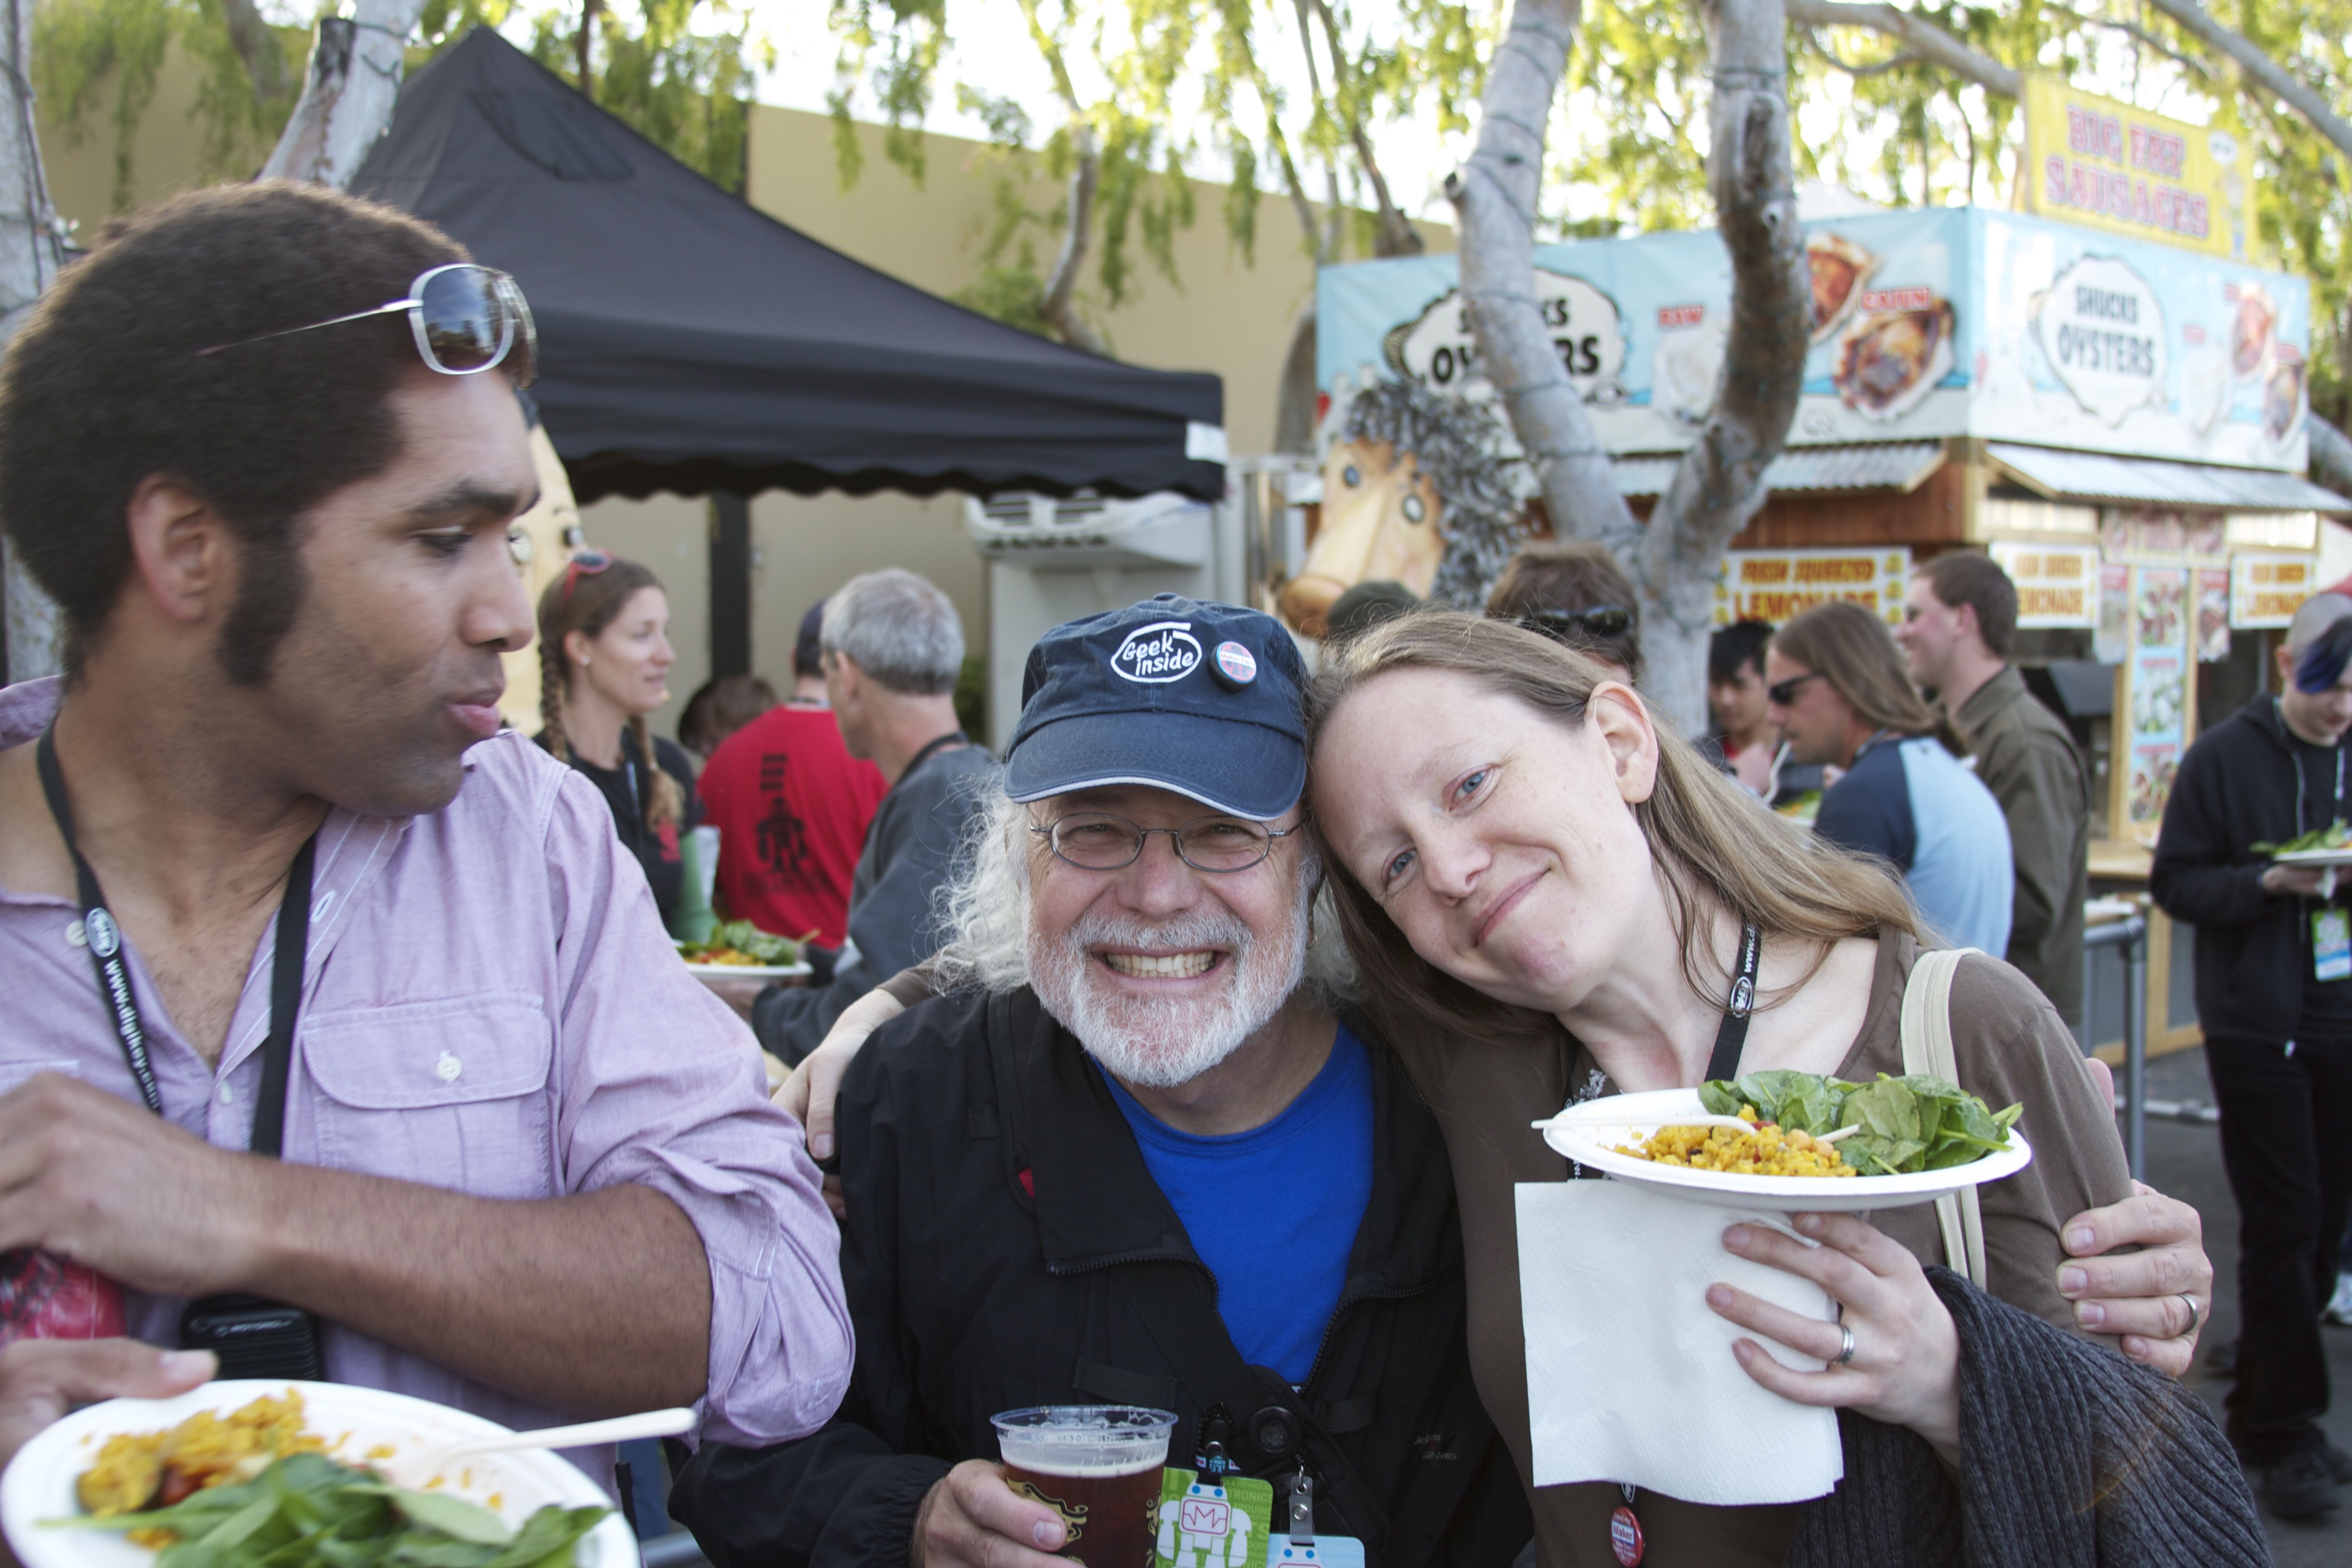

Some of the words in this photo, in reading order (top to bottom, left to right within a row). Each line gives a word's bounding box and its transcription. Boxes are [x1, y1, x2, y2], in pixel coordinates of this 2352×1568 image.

[2067, 103, 2122, 163] BIG
[2129, 122, 2185, 180] FAT
[2045, 155, 2209, 240] SAUSAGES
[2058, 326, 2156, 377] OYSTERS
[1122, 631, 1174, 661] Geek
[1220, 651, 1240, 662] Maker
[1613, 1524, 1633, 1541] Maker
